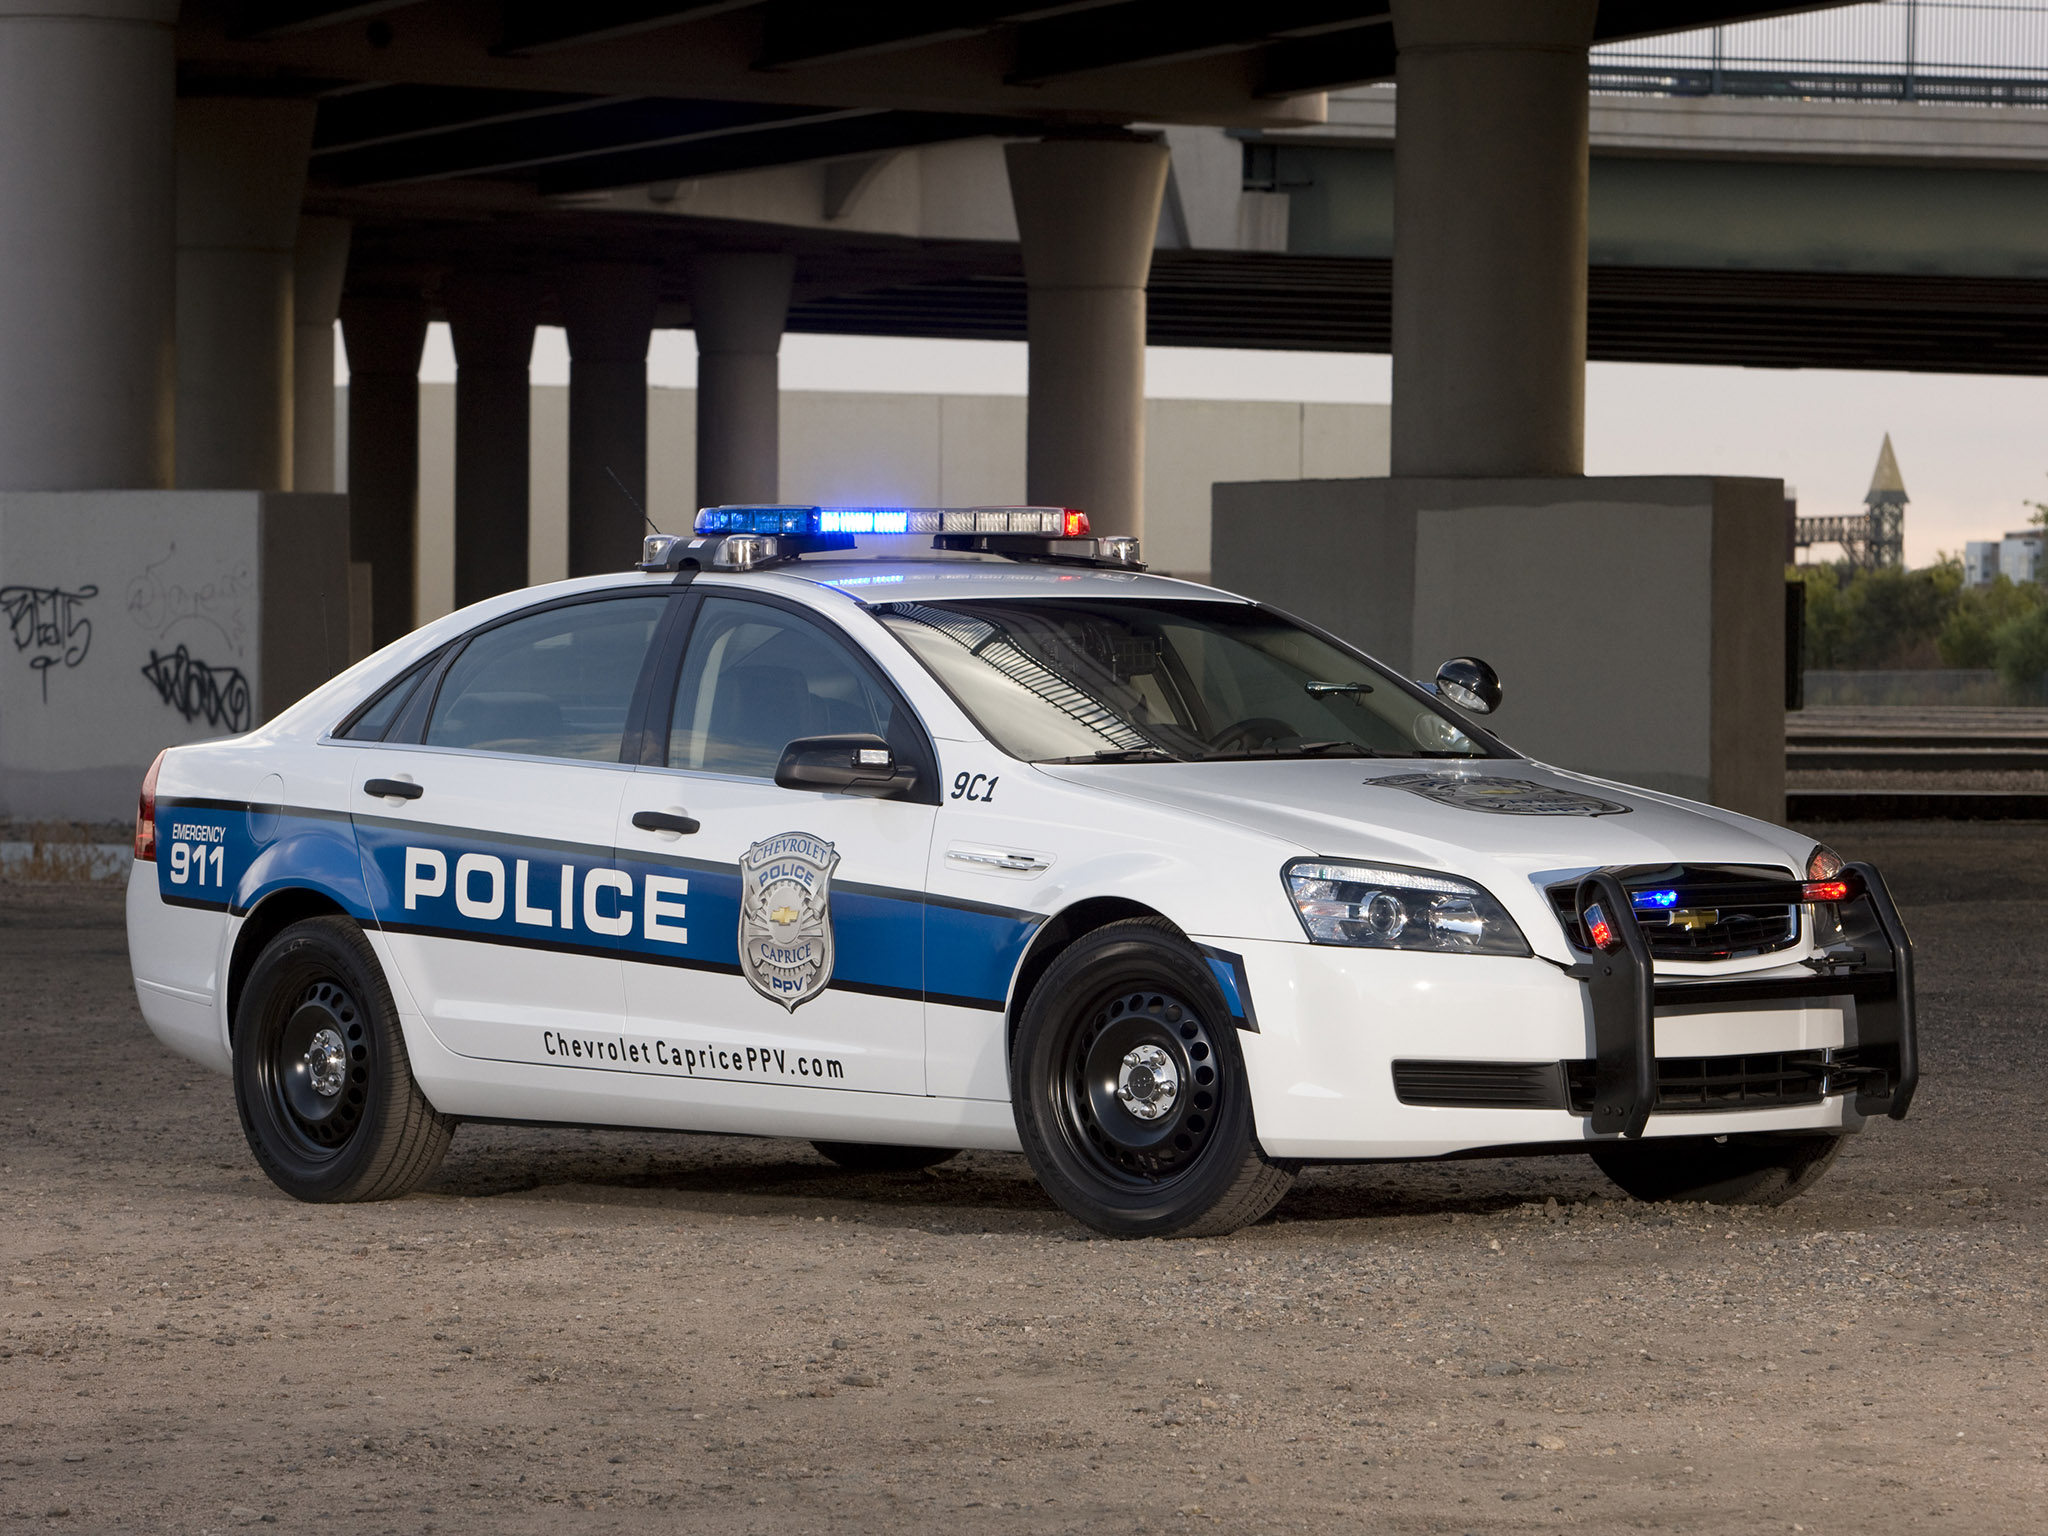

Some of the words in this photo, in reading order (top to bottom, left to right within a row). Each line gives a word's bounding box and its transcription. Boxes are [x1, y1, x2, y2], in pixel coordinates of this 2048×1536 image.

[951, 771, 999, 803] 9C1
[172, 823, 226, 843] EMERGENCY
[753, 838, 827, 864] CHEVROLET
[170, 842, 225, 887] 911
[758, 863, 815, 887] POLICE
[404, 846, 689, 944] POLICE
[761, 943, 812, 964] CAPRICE
[772, 976, 804, 993] PPV
[543, 1031, 844, 1078] ChevroletCapricePPV.com
